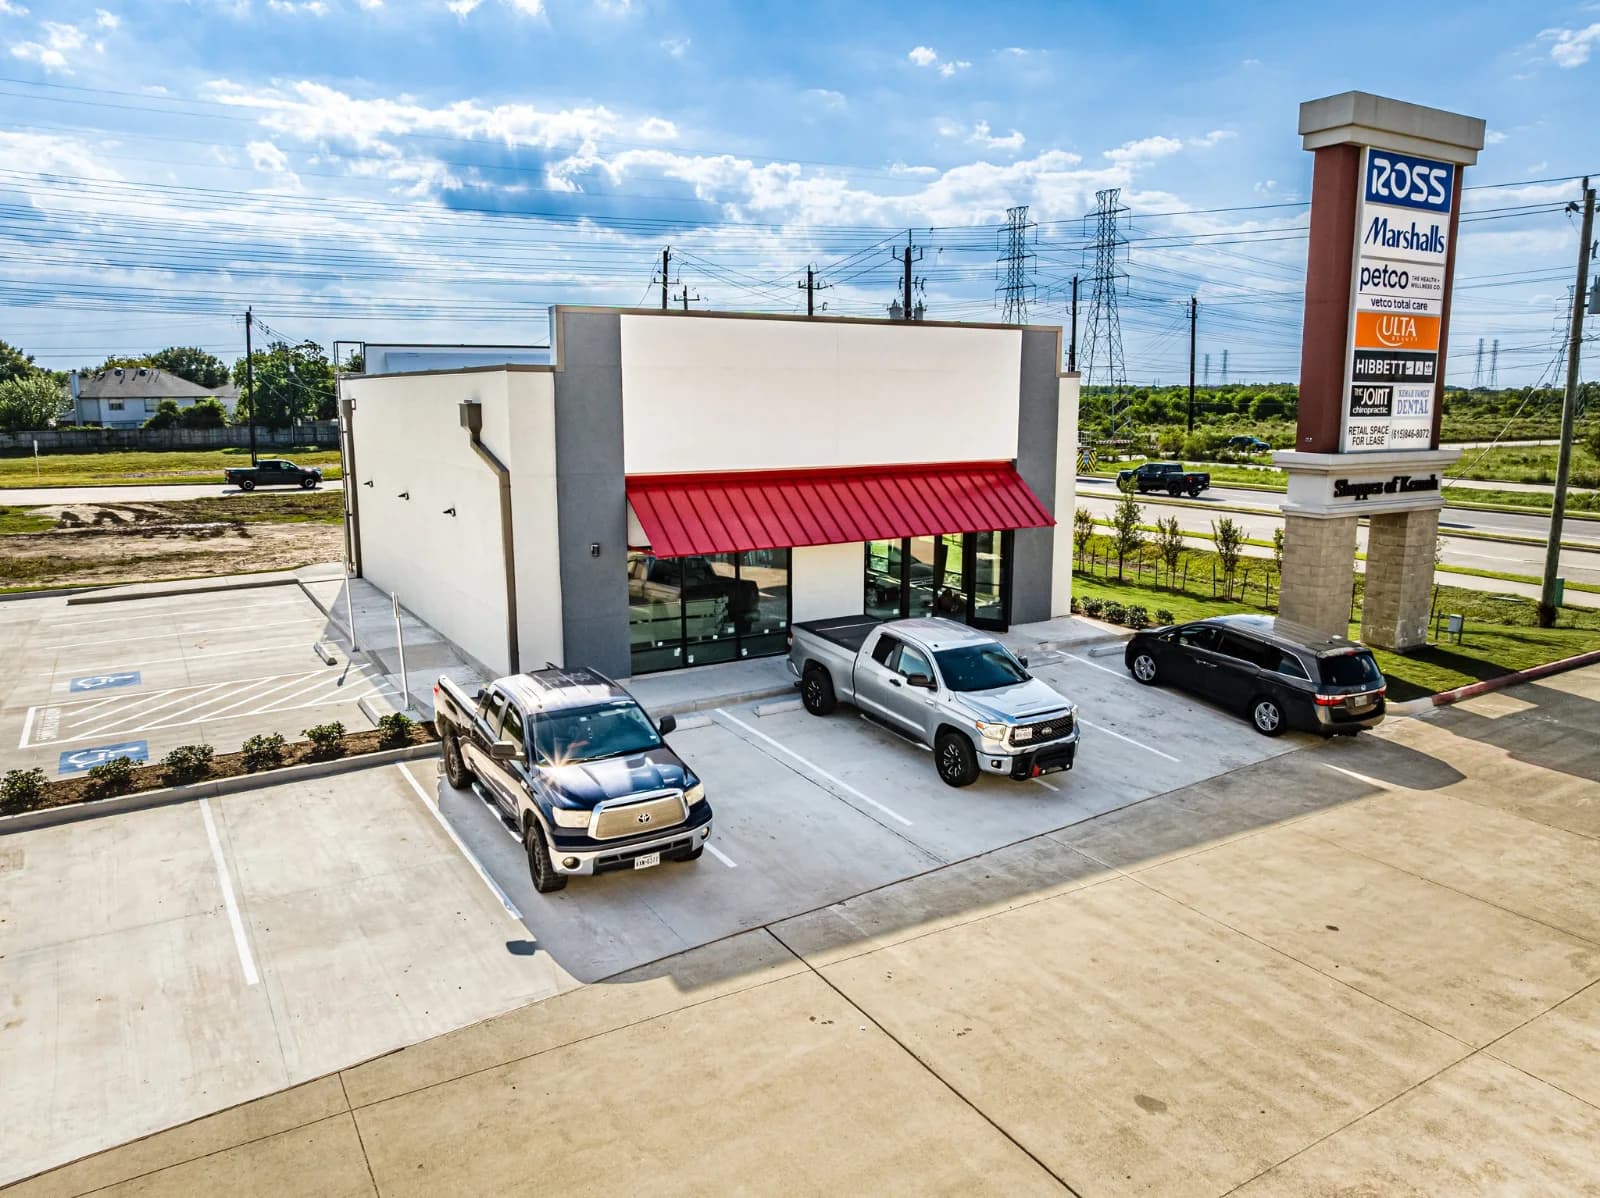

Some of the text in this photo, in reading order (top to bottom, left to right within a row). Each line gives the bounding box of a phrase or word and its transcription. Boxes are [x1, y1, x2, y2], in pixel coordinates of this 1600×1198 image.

[1371, 157, 1447, 205] ROSS
[1364, 216, 1445, 254] Marshalls
[1359, 264, 1409, 292] petco
[1371, 297, 1428, 311] vetco total care
[1382, 315, 1417, 337] ULTA
[1355, 358, 1405, 375] HIBBETT
[1361, 387, 1391, 406] JOINT
[1352, 405, 1388, 415] chiropractic
[1396, 399, 1429, 415] DENTAL
[1348, 425, 1390, 436] RETAIL SPACE
[1352, 435, 1385, 446] FOR LEASE
